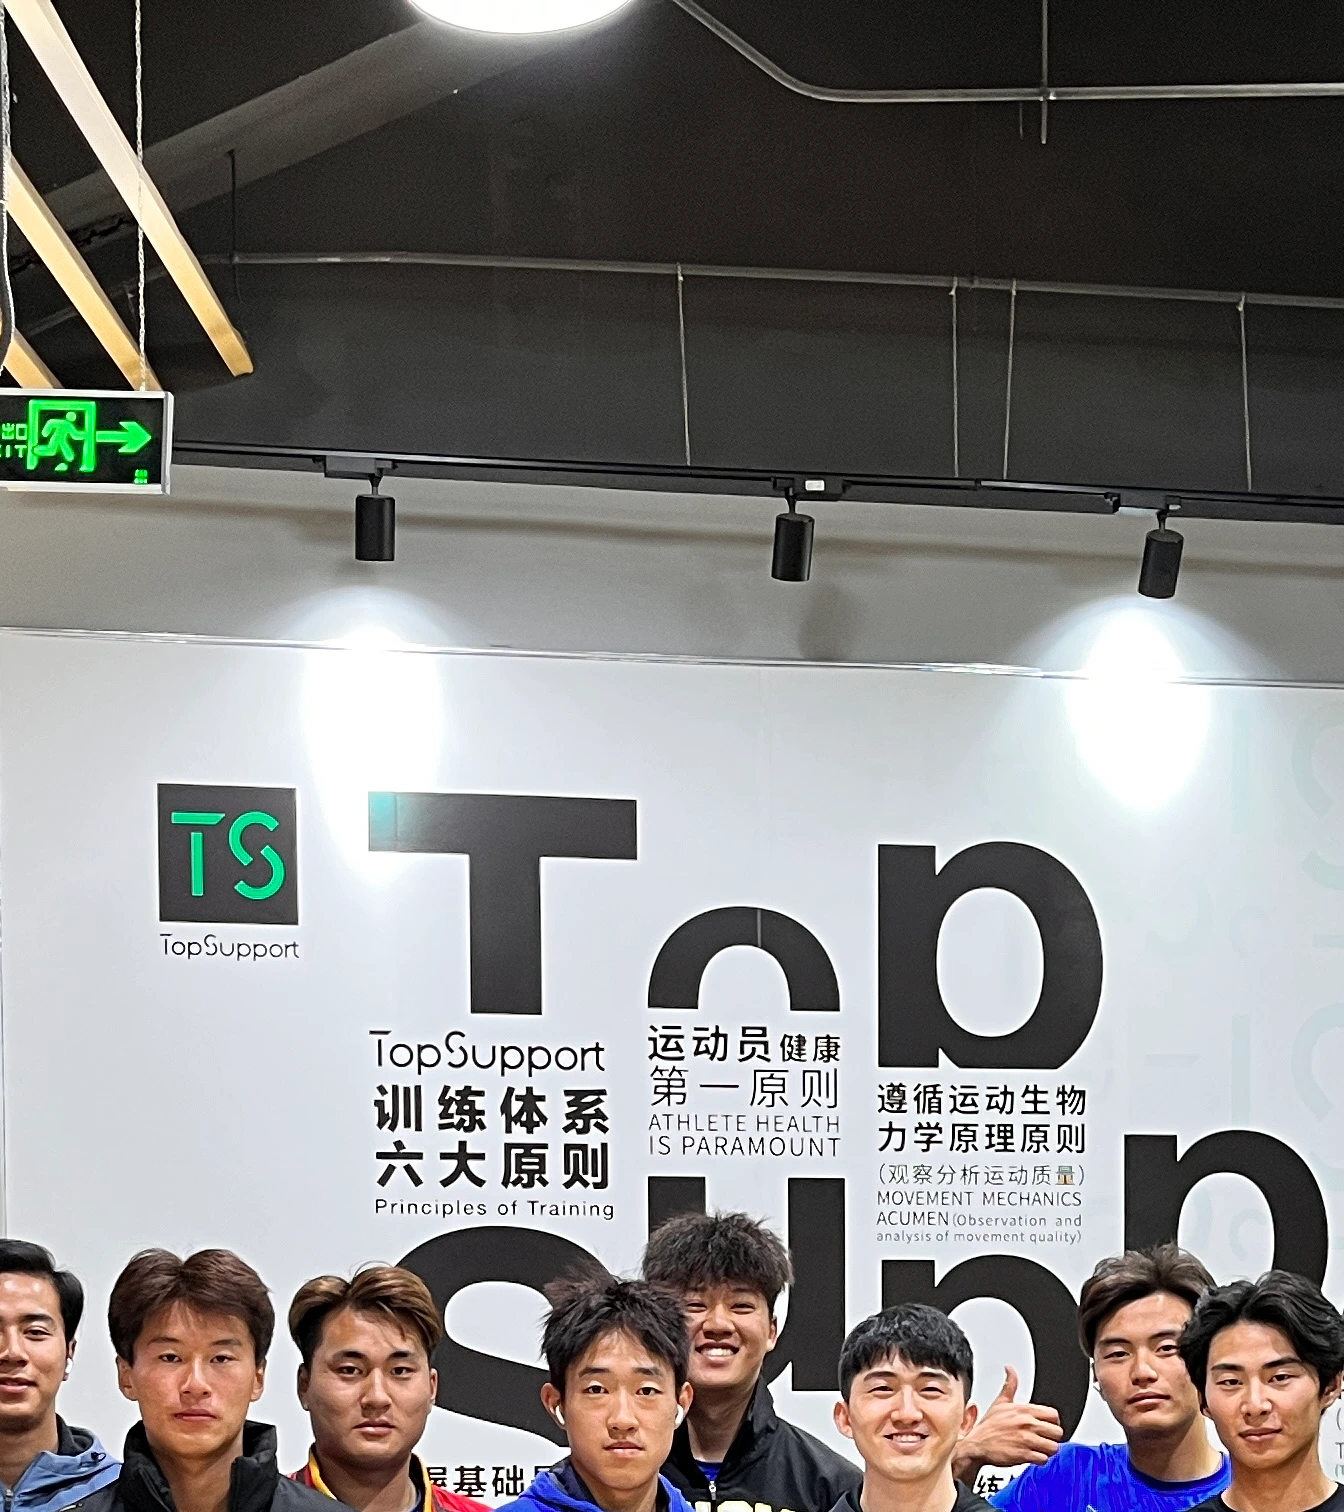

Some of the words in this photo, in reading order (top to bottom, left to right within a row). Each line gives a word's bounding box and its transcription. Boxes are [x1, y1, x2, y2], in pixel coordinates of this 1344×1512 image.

[170, 810, 286, 901] TS
[159, 933, 300, 962] TopSupport
[368, 1030, 606, 1078] TopSupport
[647, 1024, 841, 1063] 运动员健康
[649, 1065, 838, 1109] 第一原则
[877, 1082, 1087, 1116] 遵循运动生物
[373, 1084, 611, 1135] 训练体系
[648, 1113, 747, 1132] ATHLETE
[756, 1114, 840, 1133] HEALTH
[649, 1135, 671, 1155] IS
[682, 1135, 841, 1157] PARAMOUNT
[877, 1121, 1086, 1154] 力学原理原则
[374, 1139, 610, 1190] 六大原则
[878, 1163, 1085, 1186] (观察分析运动质量)
[375, 1198, 487, 1218] Principles
[497, 1200, 518, 1216] of
[527, 1201, 615, 1220] Training
[877, 1190, 974, 1206] MOVEMENT
[982, 1191, 1082, 1207] MECHANICS
[876, 1210, 949, 1226] ACUMEN
[953, 1214, 1047, 1227] (Observation
[1054, 1214, 1082, 1227] and
[876, 1230, 932, 1244] analysis
[935, 1230, 949, 1243] of
[954, 1231, 1025, 1243] movement
[1029, 1231, 1083, 1245] quality)
